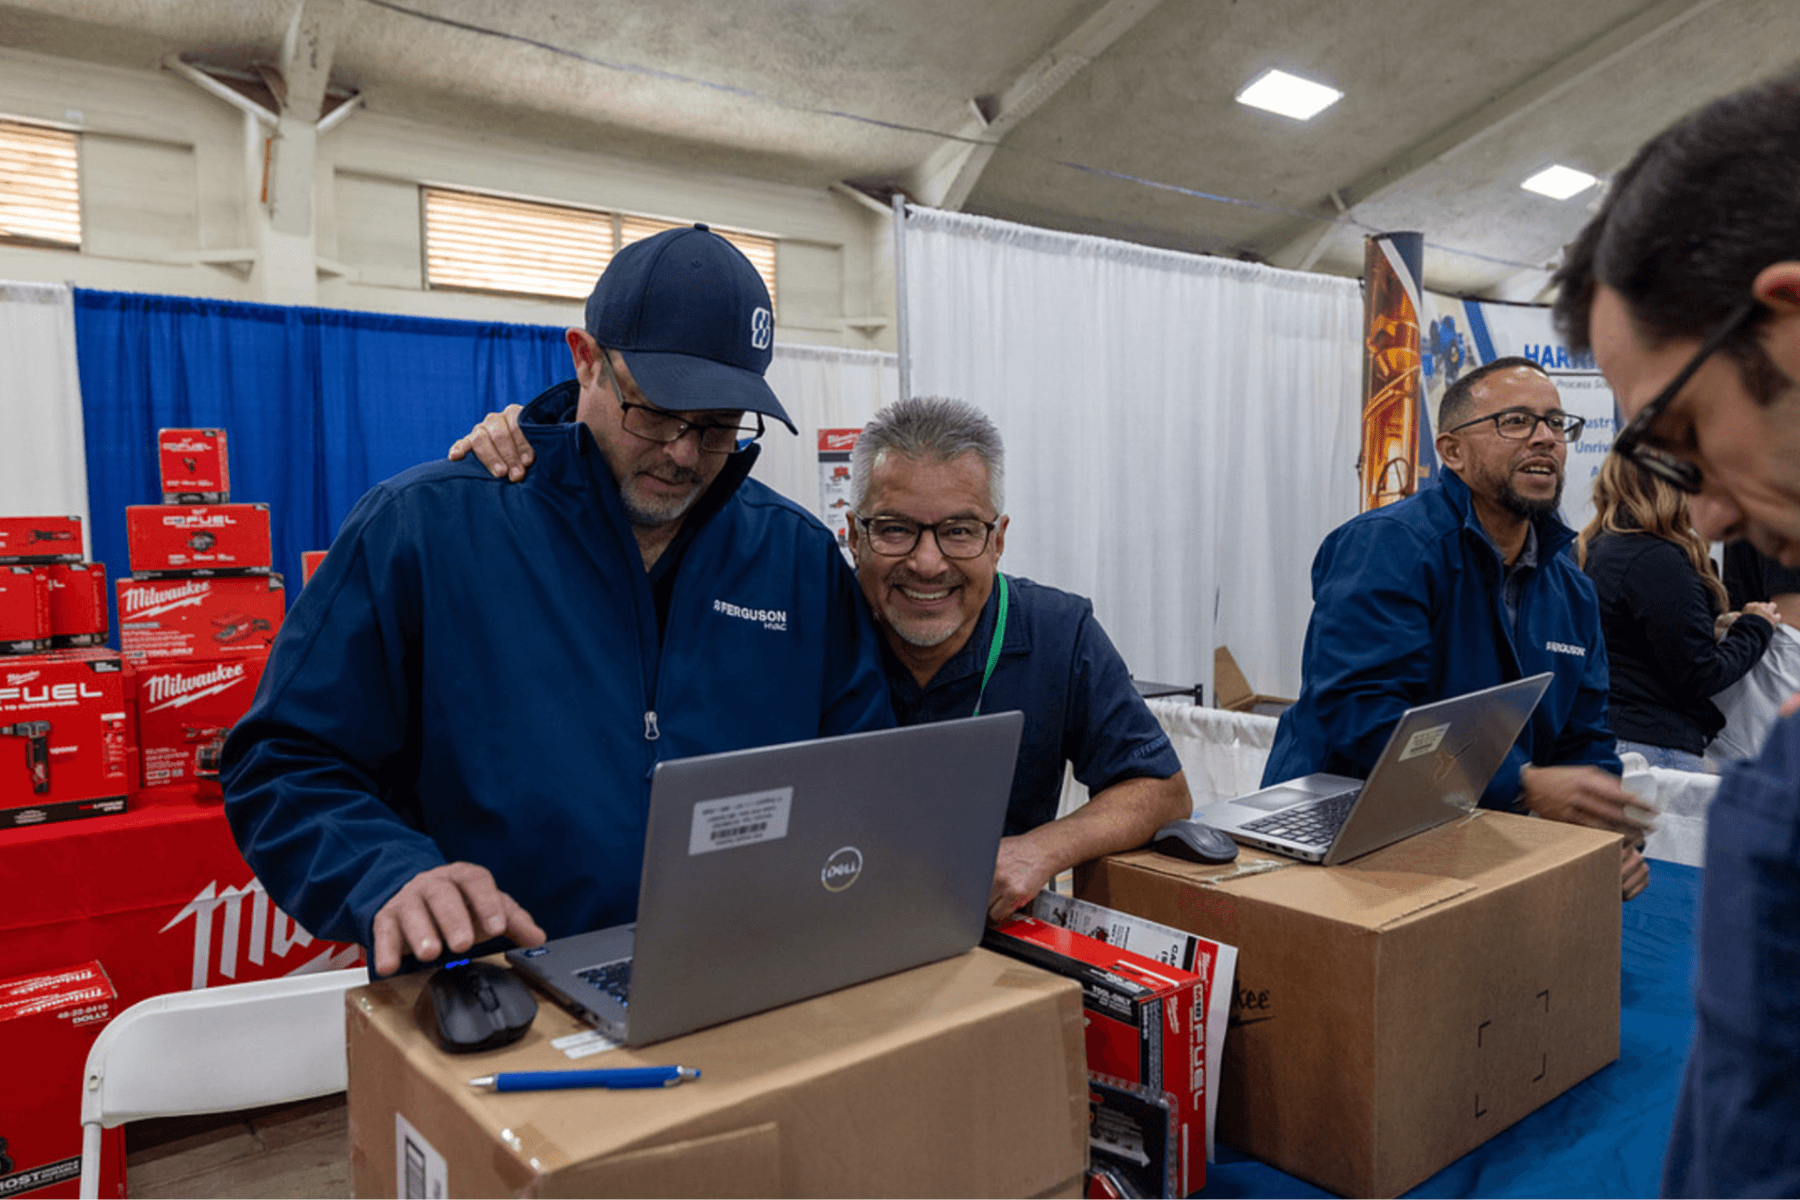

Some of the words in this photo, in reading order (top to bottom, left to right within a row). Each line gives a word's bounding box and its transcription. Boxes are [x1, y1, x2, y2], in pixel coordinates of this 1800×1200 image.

[121, 580, 210, 612] Milwaukee
[720, 601, 787, 622] FERGUSON
[0, 683, 103, 702] FUEL
[143, 664, 244, 703] Milwaukee
[827, 861, 857, 879] DELL
[1193, 1023, 1204, 1111] FUEL
